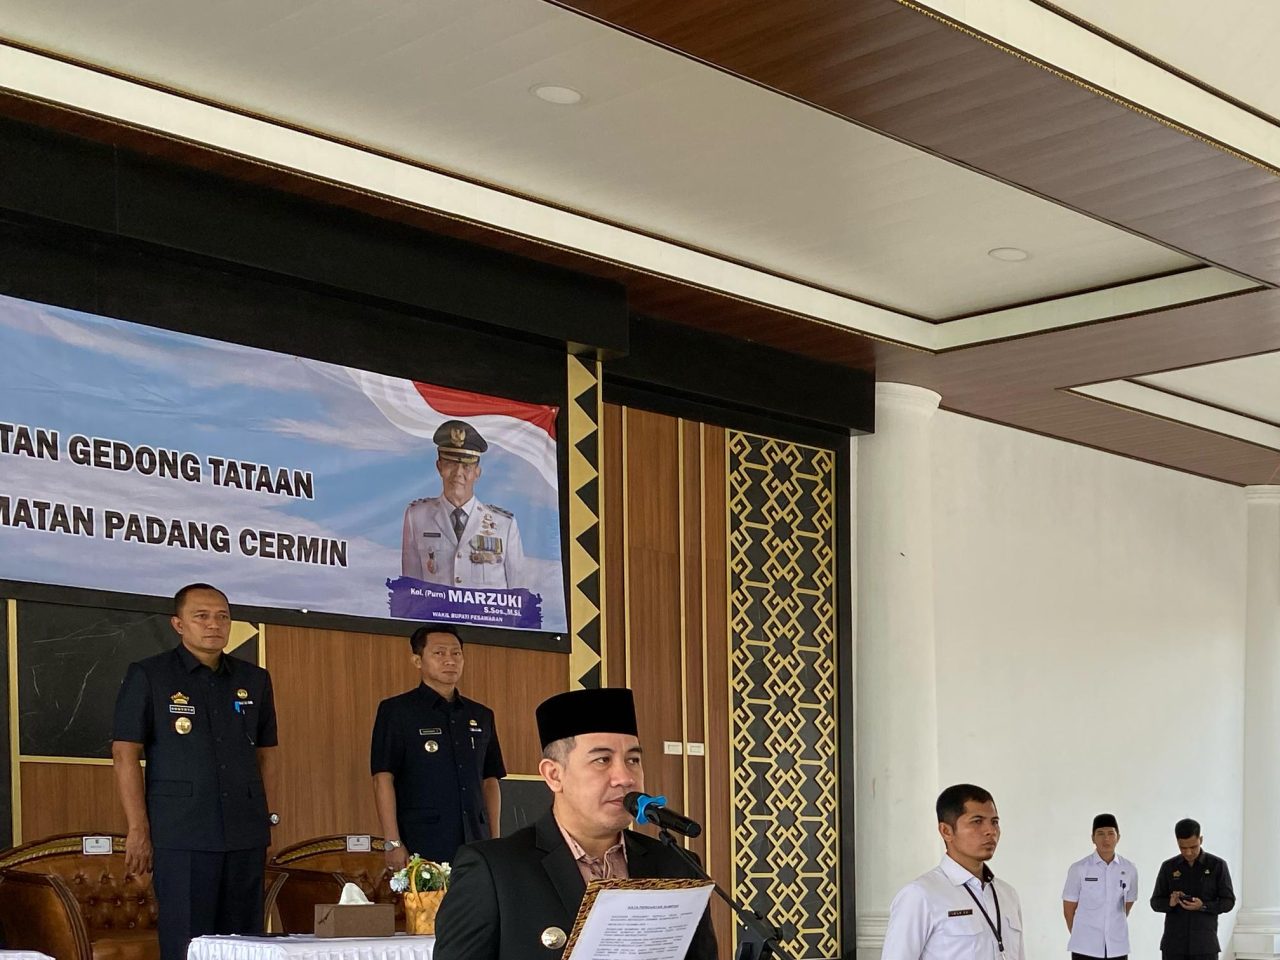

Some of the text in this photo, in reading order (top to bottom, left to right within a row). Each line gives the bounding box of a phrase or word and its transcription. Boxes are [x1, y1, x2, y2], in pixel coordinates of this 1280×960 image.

[68, 435, 201, 483] GEDONG
[207, 456, 314, 500] TATAAN
[104, 509, 231, 554] PADANG
[238, 527, 348, 567] CERMIN
[410, 587, 522, 609] Kol. (Purn) MARZUKI
[432, 611, 450, 619] WAKIL
[450, 612, 470, 621] BUPATI
